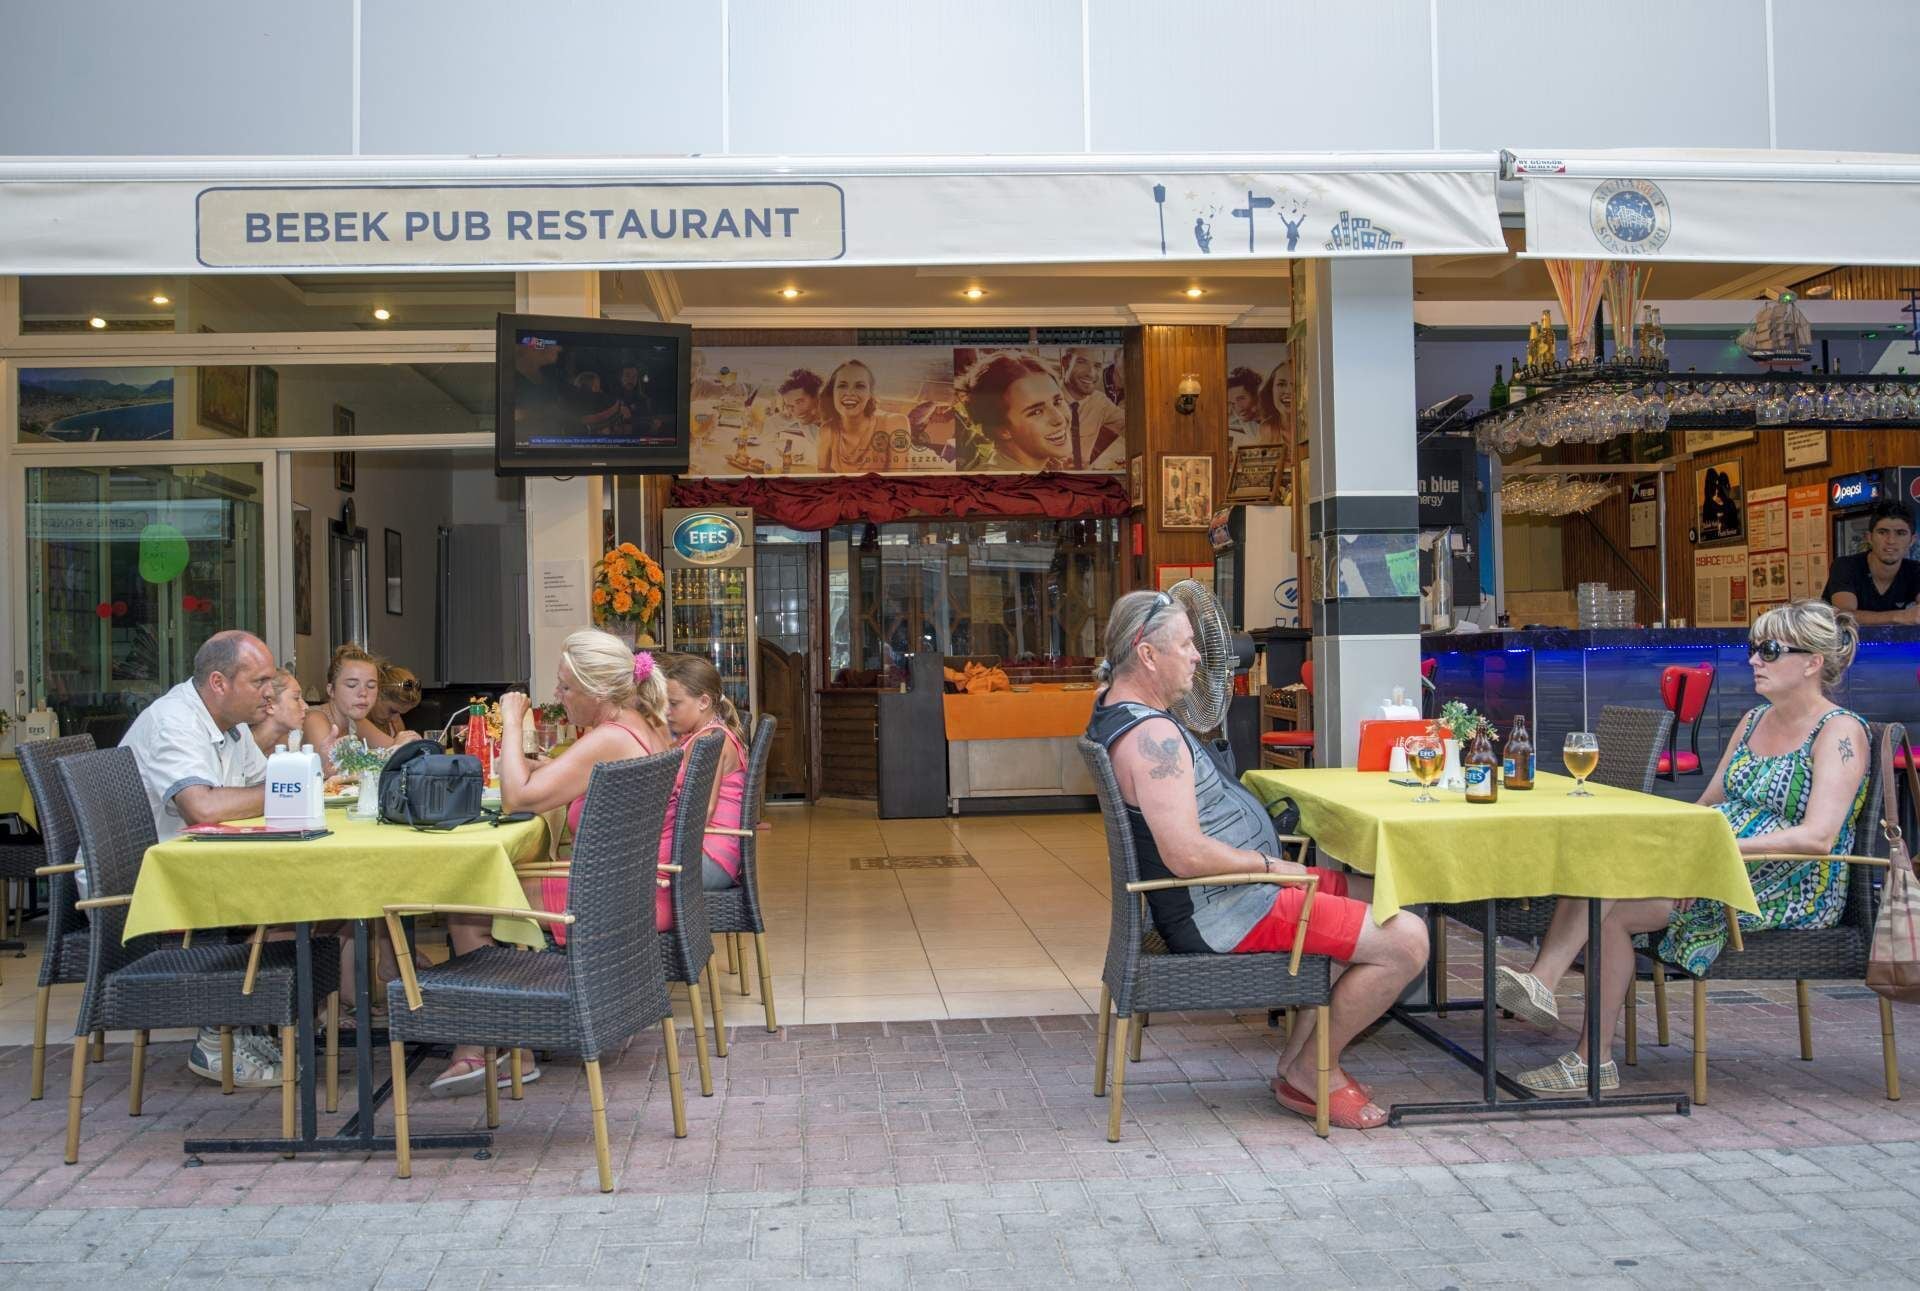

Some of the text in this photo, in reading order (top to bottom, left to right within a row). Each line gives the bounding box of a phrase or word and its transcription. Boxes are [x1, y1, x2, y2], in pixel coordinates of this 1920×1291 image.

[245, 207, 800, 243] BEBEK PUB RESTAURANT
[1431, 475, 1460, 493] blue
[1841, 482, 1862, 500] pepsi
[1418, 495, 1444, 507] nergy
[689, 530, 728, 545] EFES
[271, 782, 302, 793] EFES
